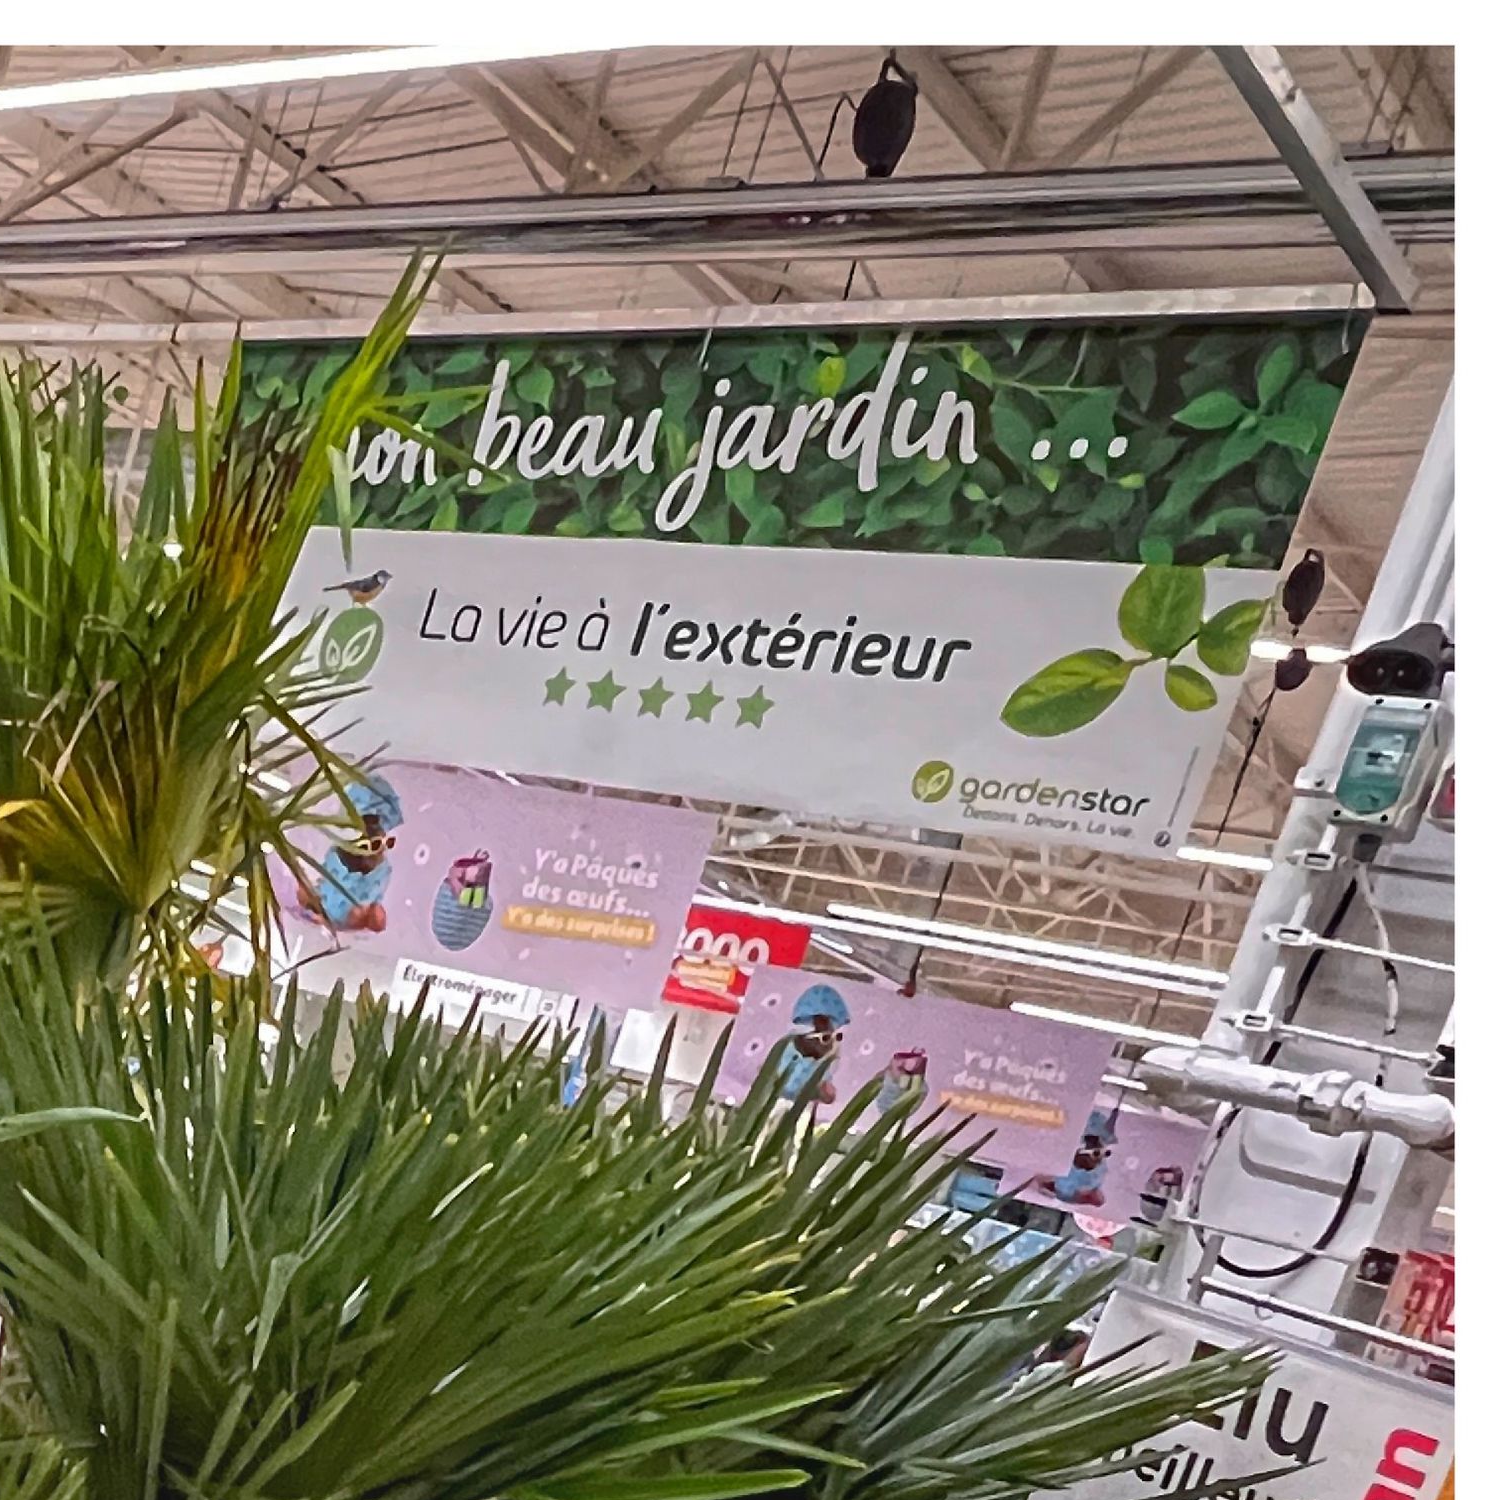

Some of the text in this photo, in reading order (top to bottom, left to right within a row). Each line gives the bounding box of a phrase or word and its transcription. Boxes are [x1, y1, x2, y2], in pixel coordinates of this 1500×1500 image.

[346, 425, 437, 486] on
[467, 359, 663, 486] beau
[655, 331, 979, 531] jardin
[419, 587, 973, 684] La vie à l'extérieur
[958, 777, 1151, 817] gardenstar
[522, 876, 561, 904] des
